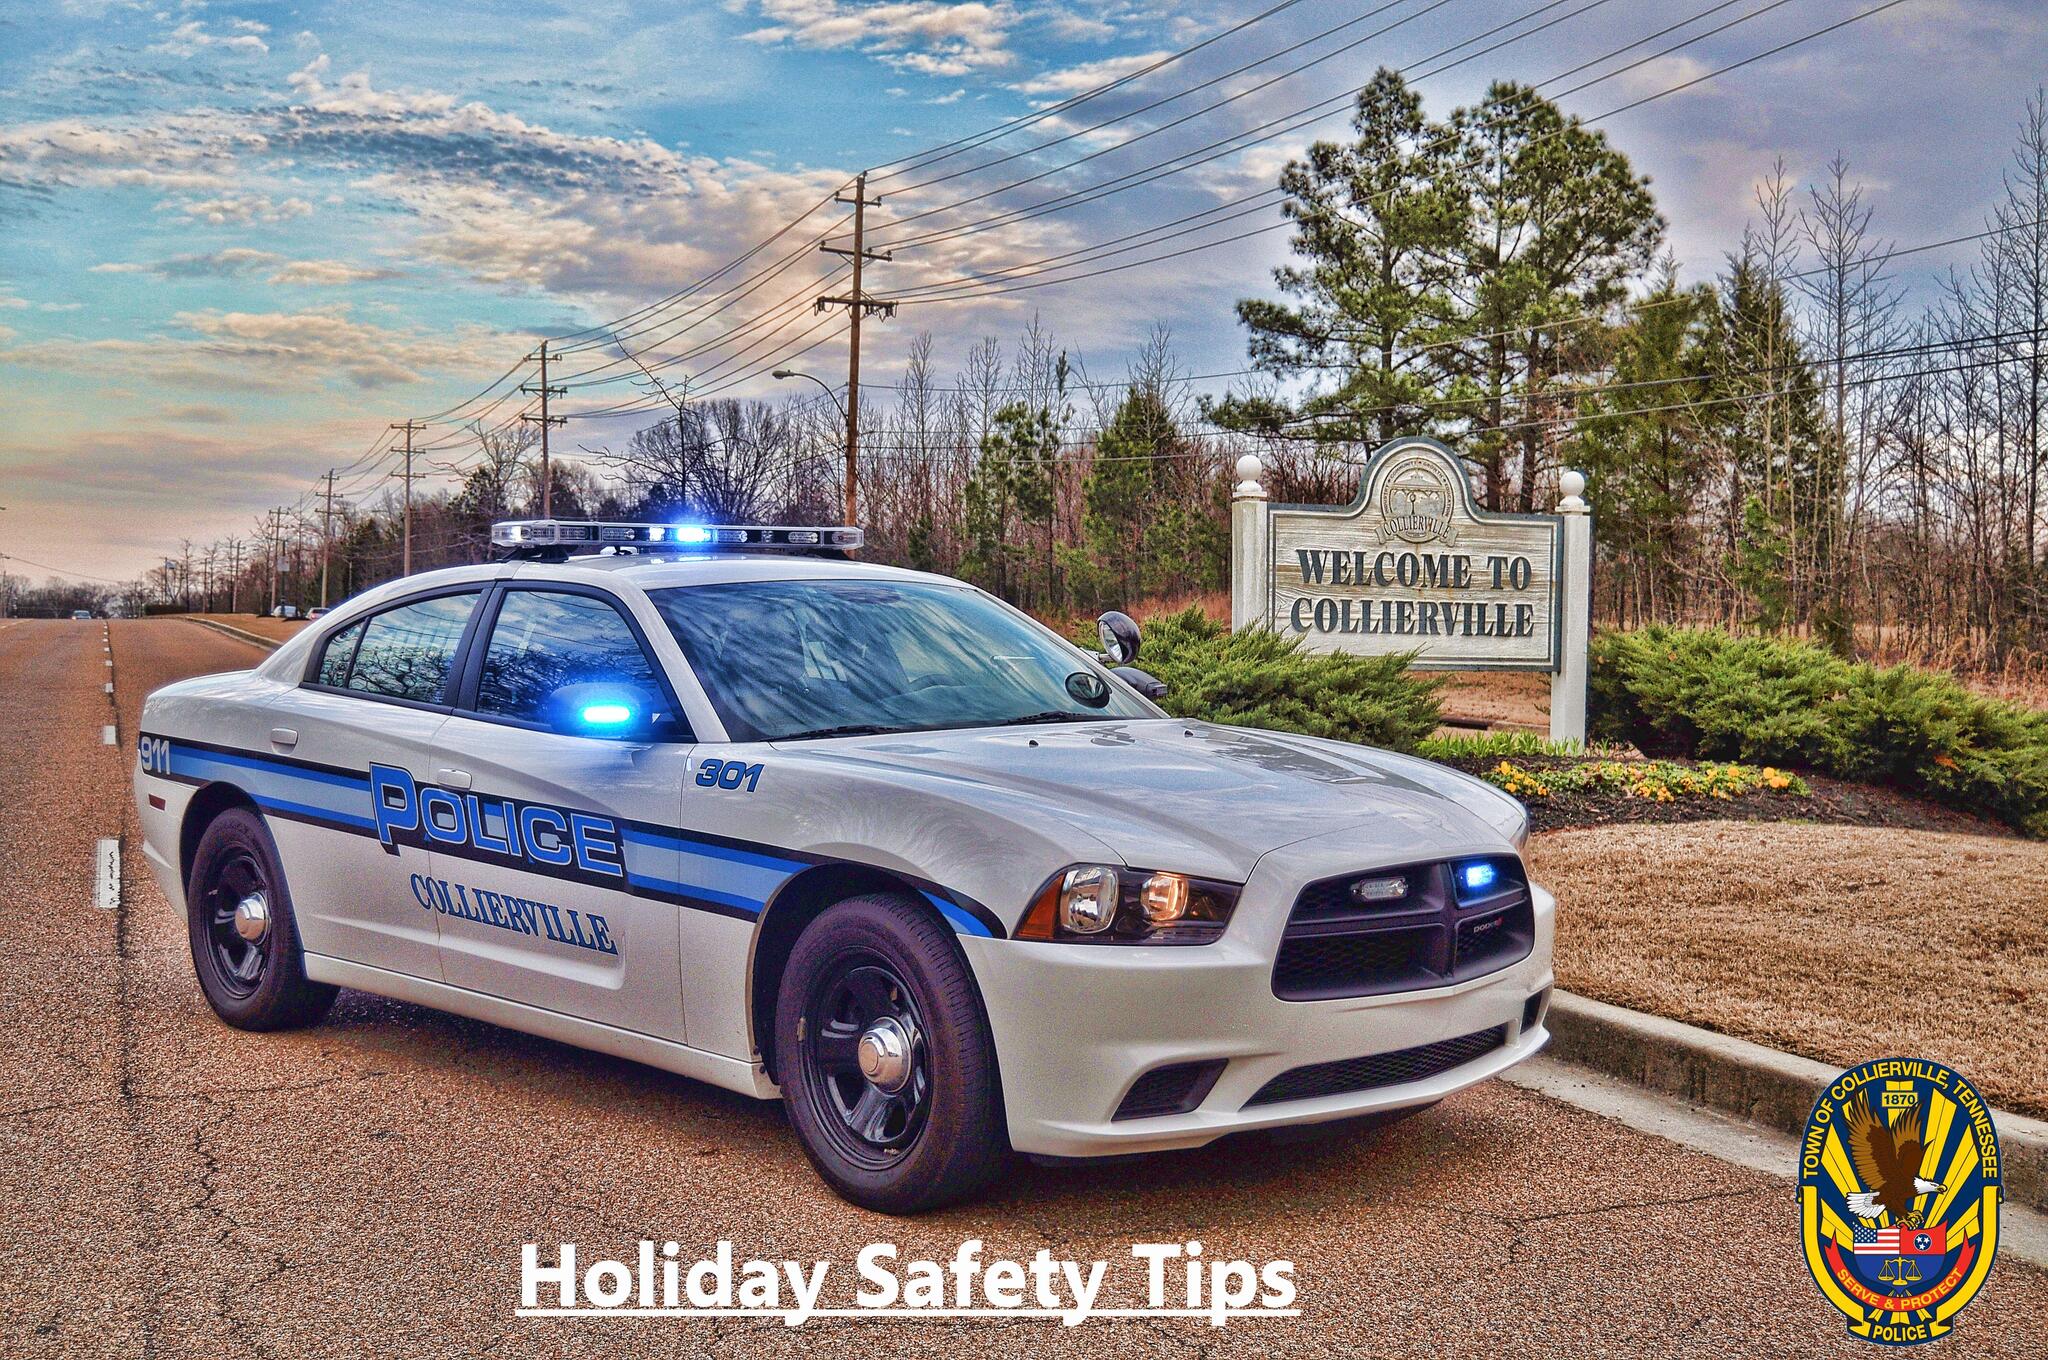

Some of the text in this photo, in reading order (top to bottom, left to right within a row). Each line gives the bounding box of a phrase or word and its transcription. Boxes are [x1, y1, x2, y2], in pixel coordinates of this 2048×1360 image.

[1422, 461, 1444, 478] GROWTH
[1384, 515, 1450, 538] COLLIERVILLE
[1296, 548, 1533, 591] WELCOME TO
[1290, 597, 1534, 637] COLLIERVILLE
[140, 735, 170, 775] 911
[695, 758, 764, 792] 301
[369, 761, 624, 877] POLICE
[410, 873, 619, 955] COLLIERVILLE
